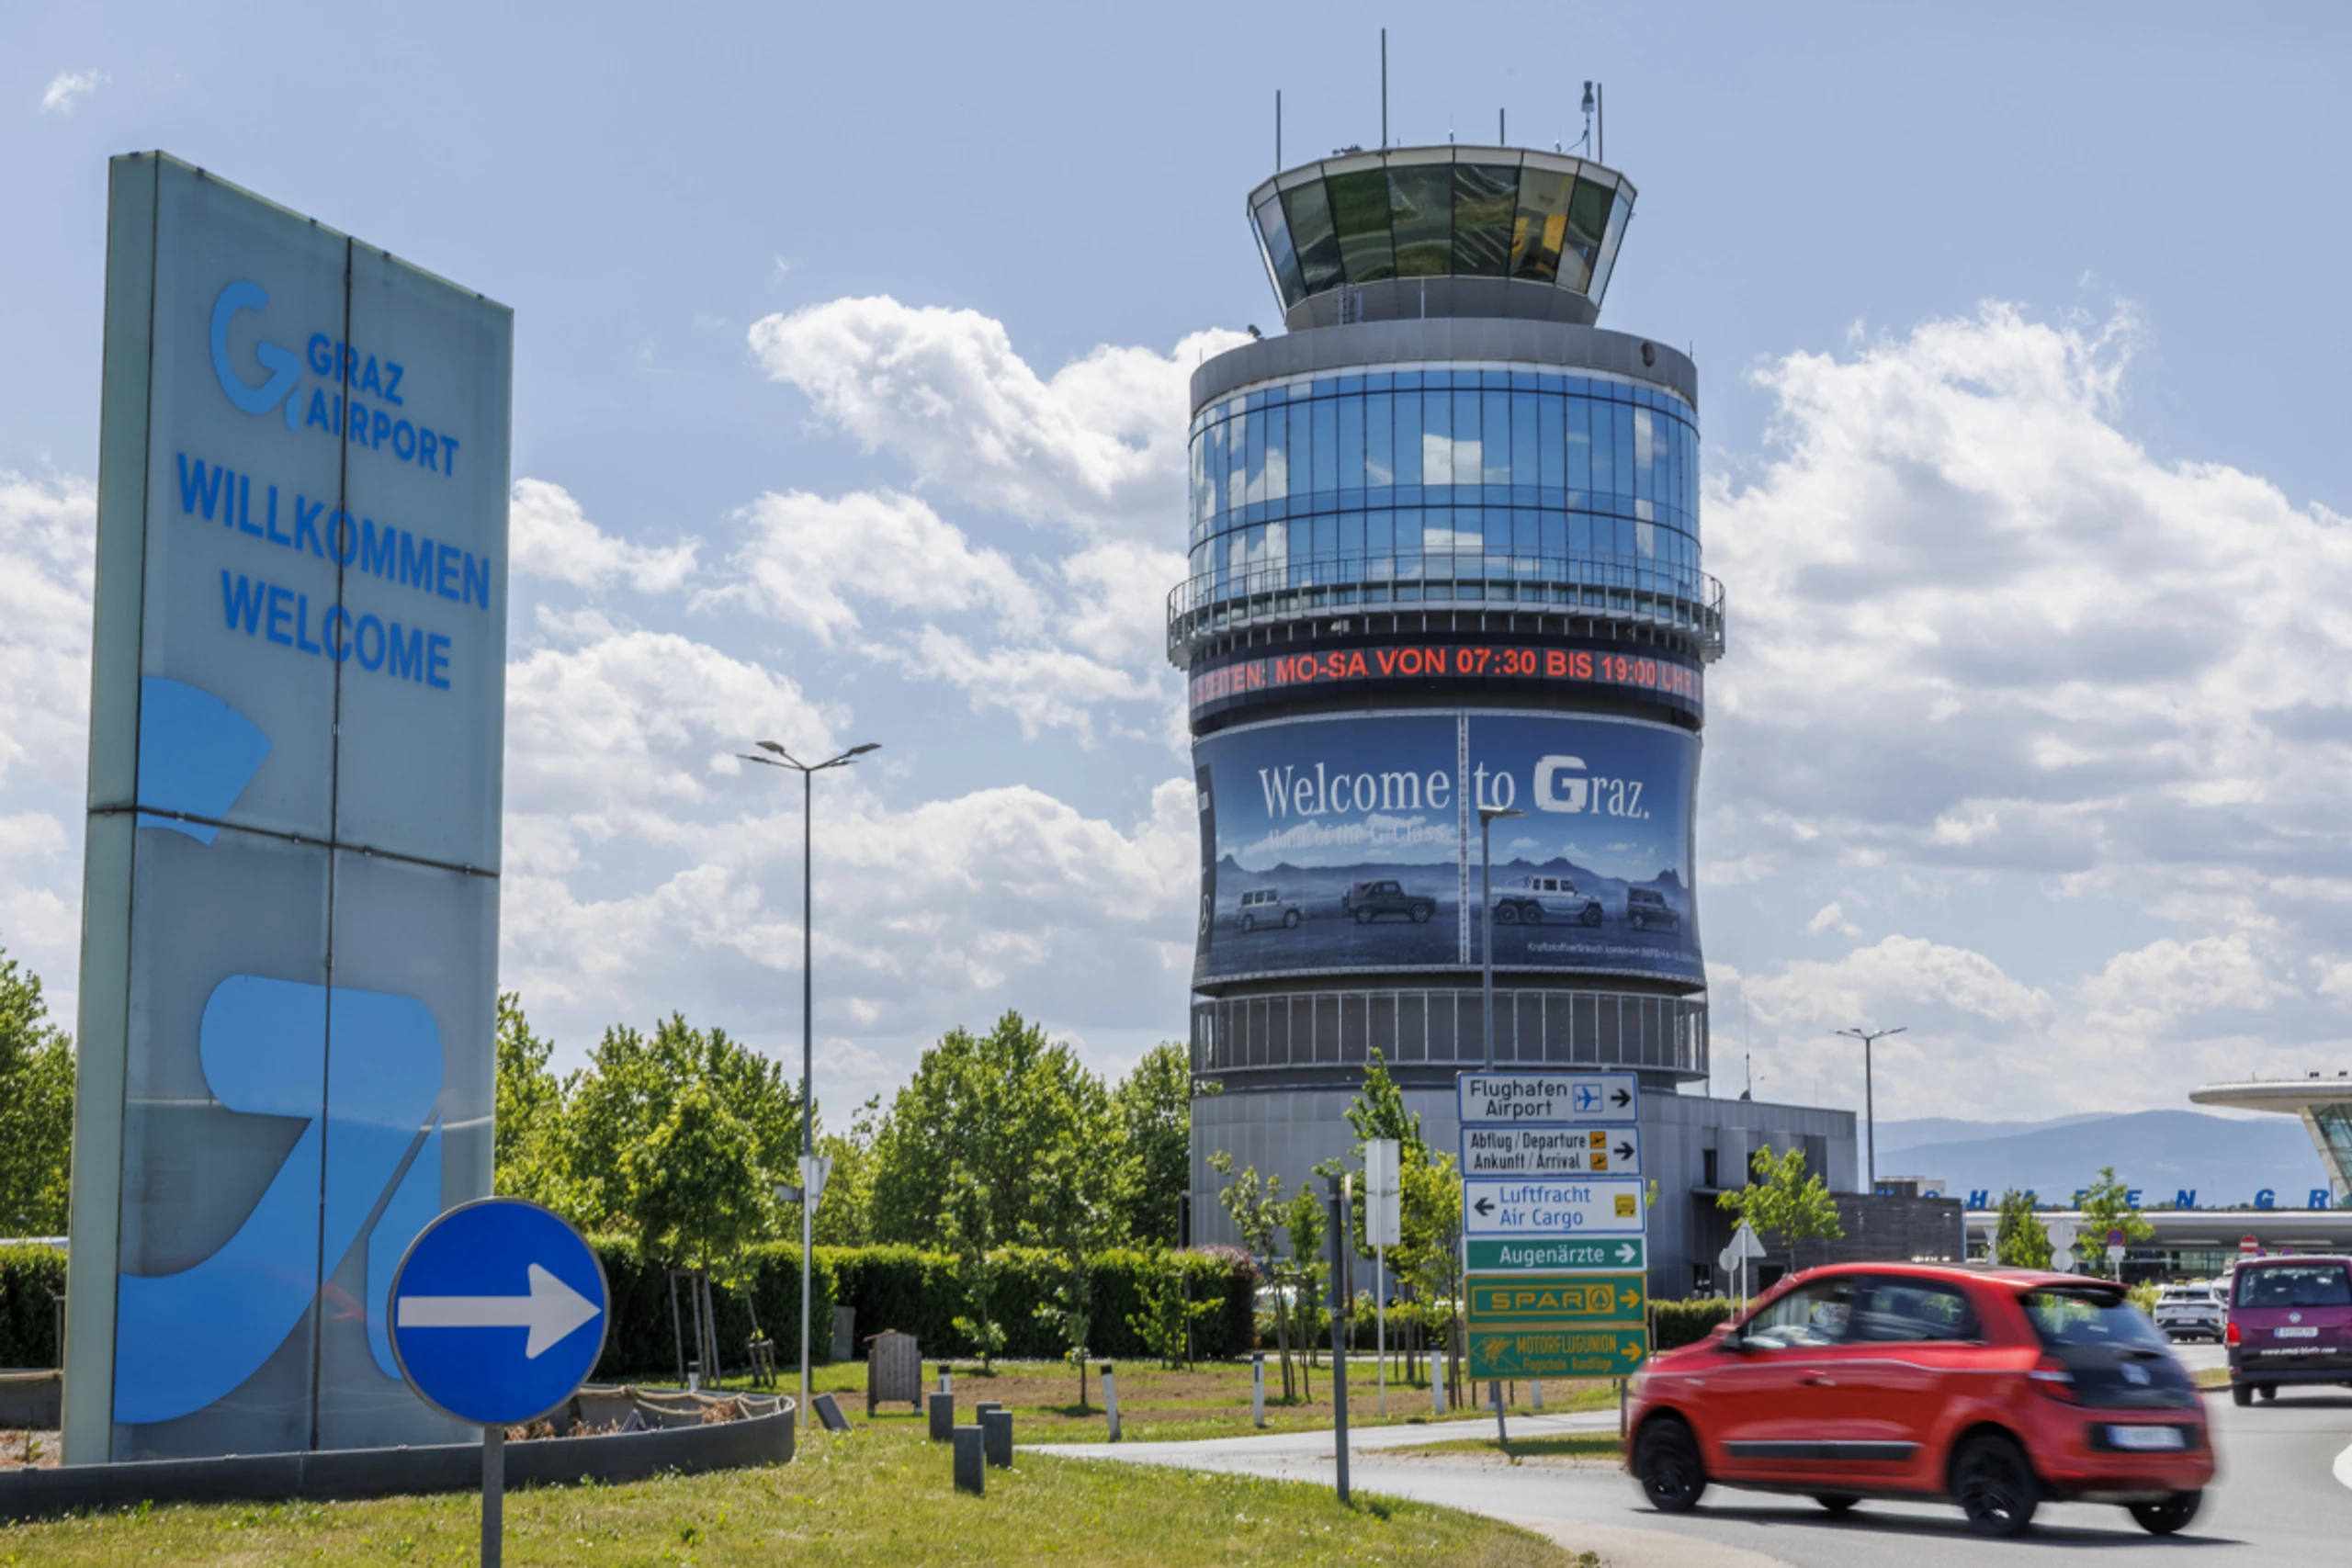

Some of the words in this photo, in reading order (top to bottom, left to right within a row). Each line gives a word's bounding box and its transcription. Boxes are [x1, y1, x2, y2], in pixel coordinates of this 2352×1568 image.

[307, 333, 404, 406] GRAZ
[306, 389, 459, 478] AIRPORT
[176, 451, 491, 612] WILLKOMMEN
[221, 568, 452, 691] WELCOME
[1275, 650, 1369, 684] MO-SA
[1376, 648, 1446, 675] VON
[1456, 648, 1536, 675] 07:30
[1546, 649, 1593, 679] BIS
[1601, 655, 1657, 686] 19:00
[1661, 664, 1692, 694] UHR
[1259, 761, 1451, 818] Welcome
[1473, 761, 1516, 809] to
[1533, 754, 1651, 820] Graz.
[1470, 1079, 1567, 1100] Flughafen
[1486, 1099, 1553, 1120] Airport
[1471, 1132, 1512, 1153] Abflug
[1522, 1132, 1587, 1152] Departure
[1474, 1153, 1525, 1170] Ankunft
[1536, 1152, 1581, 1170] Arrival
[1499, 1186, 1591, 1204] Luftfracht
[1499, 1209, 1525, 1226] Air
[1532, 1209, 1584, 1230] Cargo
[1499, 1245, 1605, 1268] Augenärzte
[1490, 1292, 1583, 1310] SPAR
[1516, 1334, 1617, 1355] MOTORFLUGUNION
